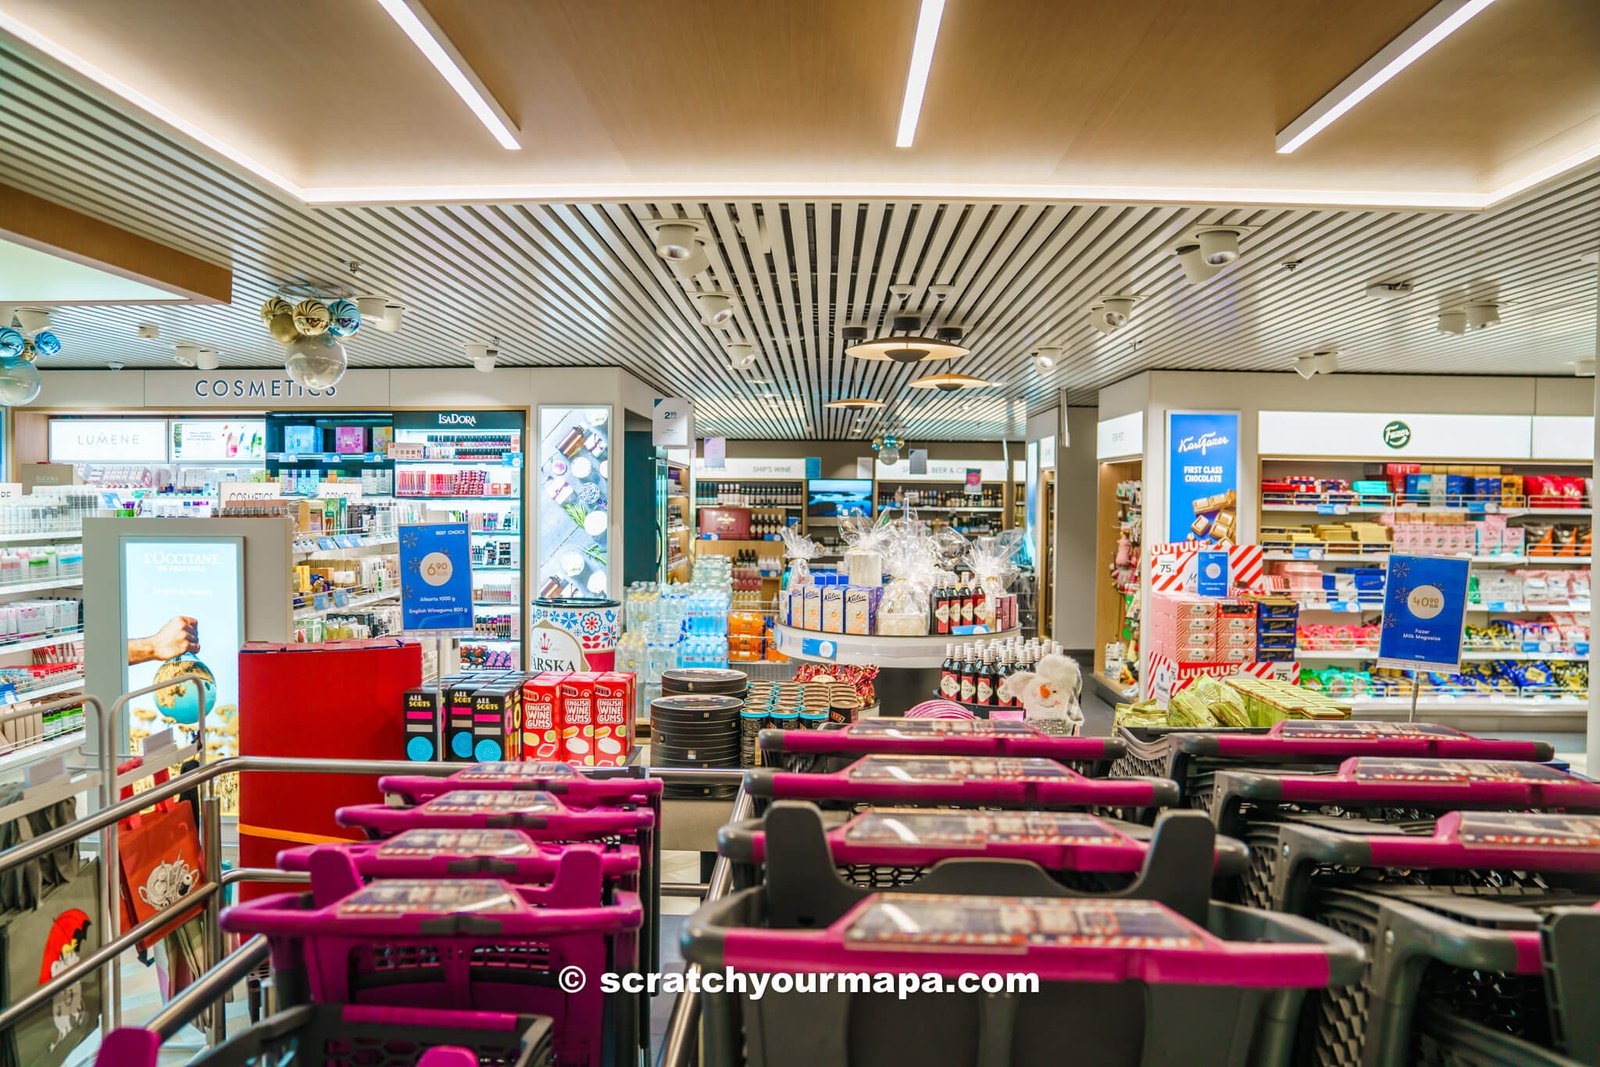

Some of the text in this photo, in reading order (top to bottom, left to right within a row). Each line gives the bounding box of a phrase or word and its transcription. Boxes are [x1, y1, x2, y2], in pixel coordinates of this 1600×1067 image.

[77, 433, 140, 446] LUMENE
[1184, 466, 1223, 474] FIRST CLASS
[1184, 474, 1222, 483] CHOCOLATE
[1151, 540, 1208, 556] UUTUUS
[1180, 664, 1240, 680] UUTUUS
[527, 711, 550, 719] WINE
[566, 706, 589, 715] WINE
[599, 706, 621, 715] WINE
[527, 719, 551, 728] GUMS
